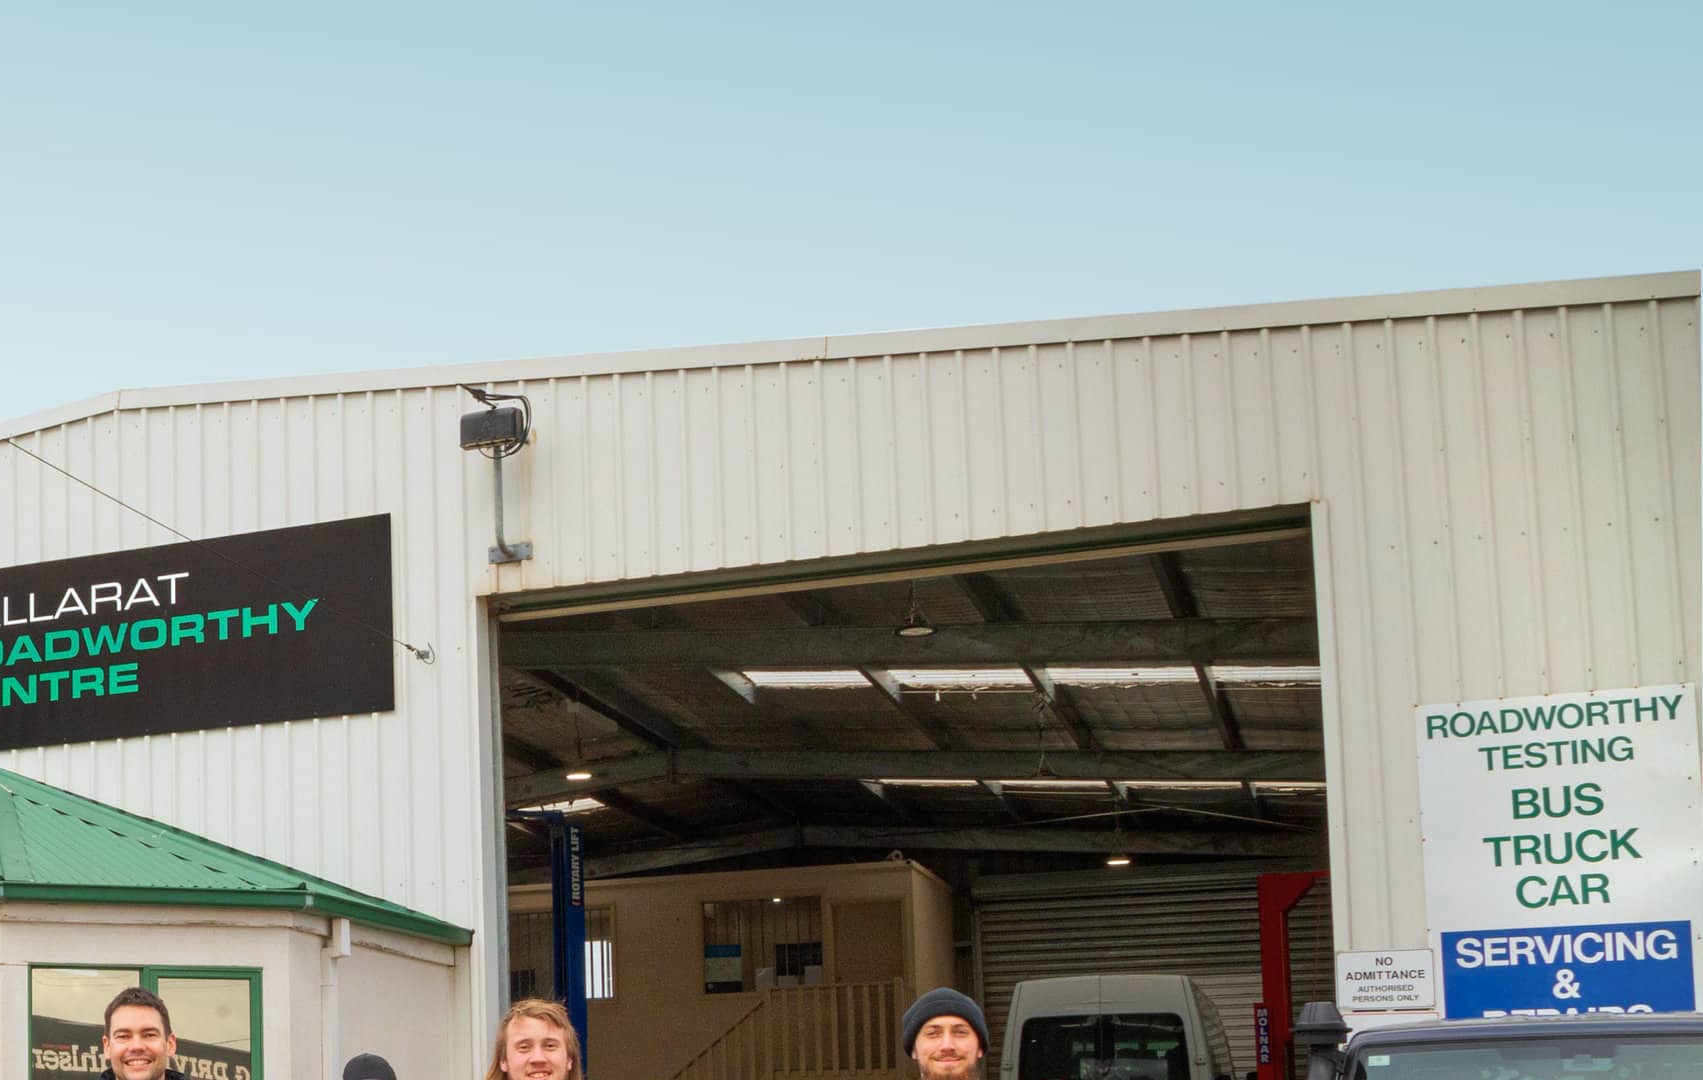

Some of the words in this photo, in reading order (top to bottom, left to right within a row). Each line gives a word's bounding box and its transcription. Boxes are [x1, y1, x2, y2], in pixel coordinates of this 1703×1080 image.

[1426, 694, 1683, 739] ROADWORTHY
[1477, 736, 1634, 771] TESTING
[1511, 782, 1604, 820] BUS
[571, 827, 580, 851] LIFT
[1482, 827, 1643, 867] TRUCK
[571, 859, 580, 900] ROTARY
[1516, 873, 1611, 909] CAR
[1375, 956, 1393, 966] NO
[1456, 929, 1678, 969] SERVICING
[1345, 969, 1426, 981] ADMITTANCE
[1357, 984, 1414, 993] AUTHORISED
[1552, 969, 1581, 999] &
[1257, 1009, 1270, 1063] MOLNAR
